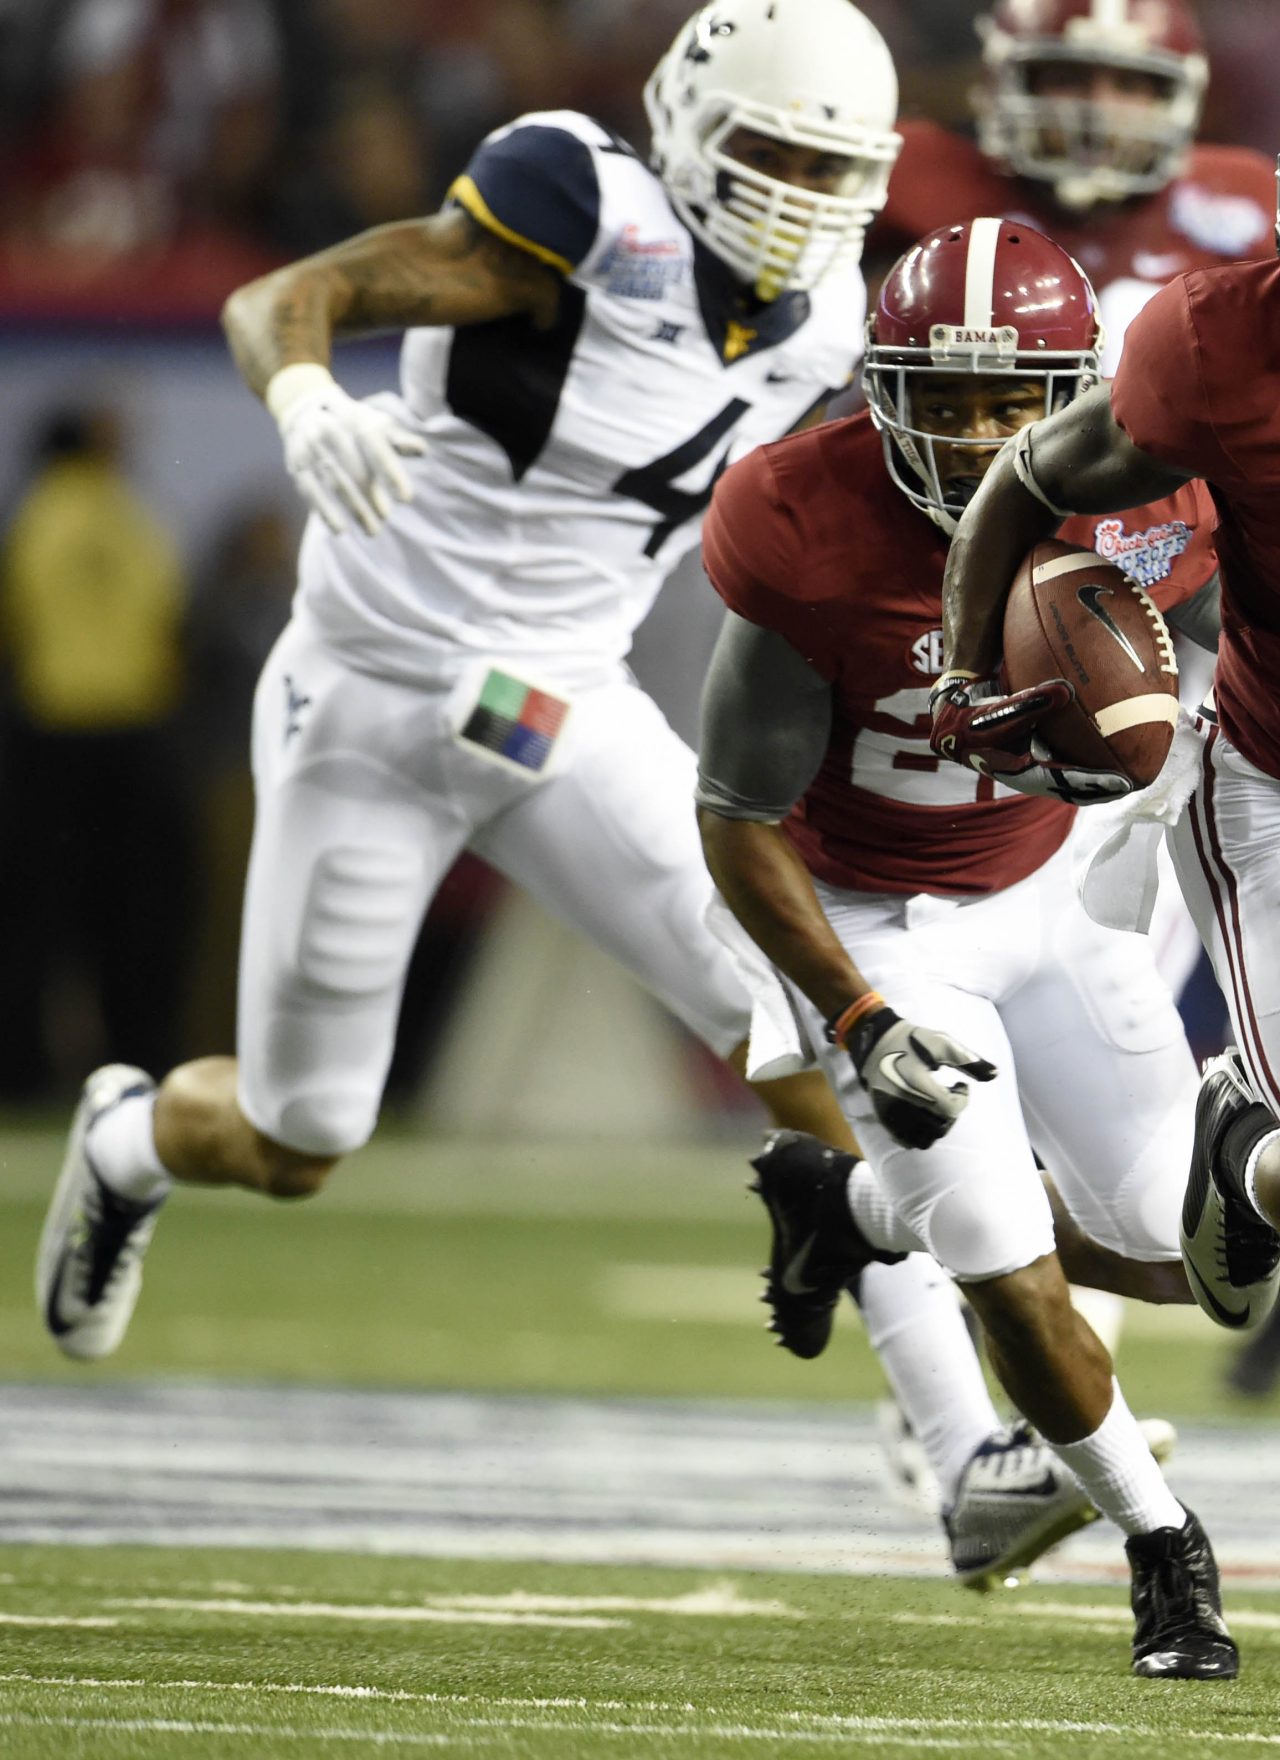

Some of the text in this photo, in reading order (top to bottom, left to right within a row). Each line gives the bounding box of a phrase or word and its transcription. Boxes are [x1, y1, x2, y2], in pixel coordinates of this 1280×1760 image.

[955, 331, 997, 343] BAMA
[613, 397, 752, 559] 4
[912, 630, 943, 674] SE
